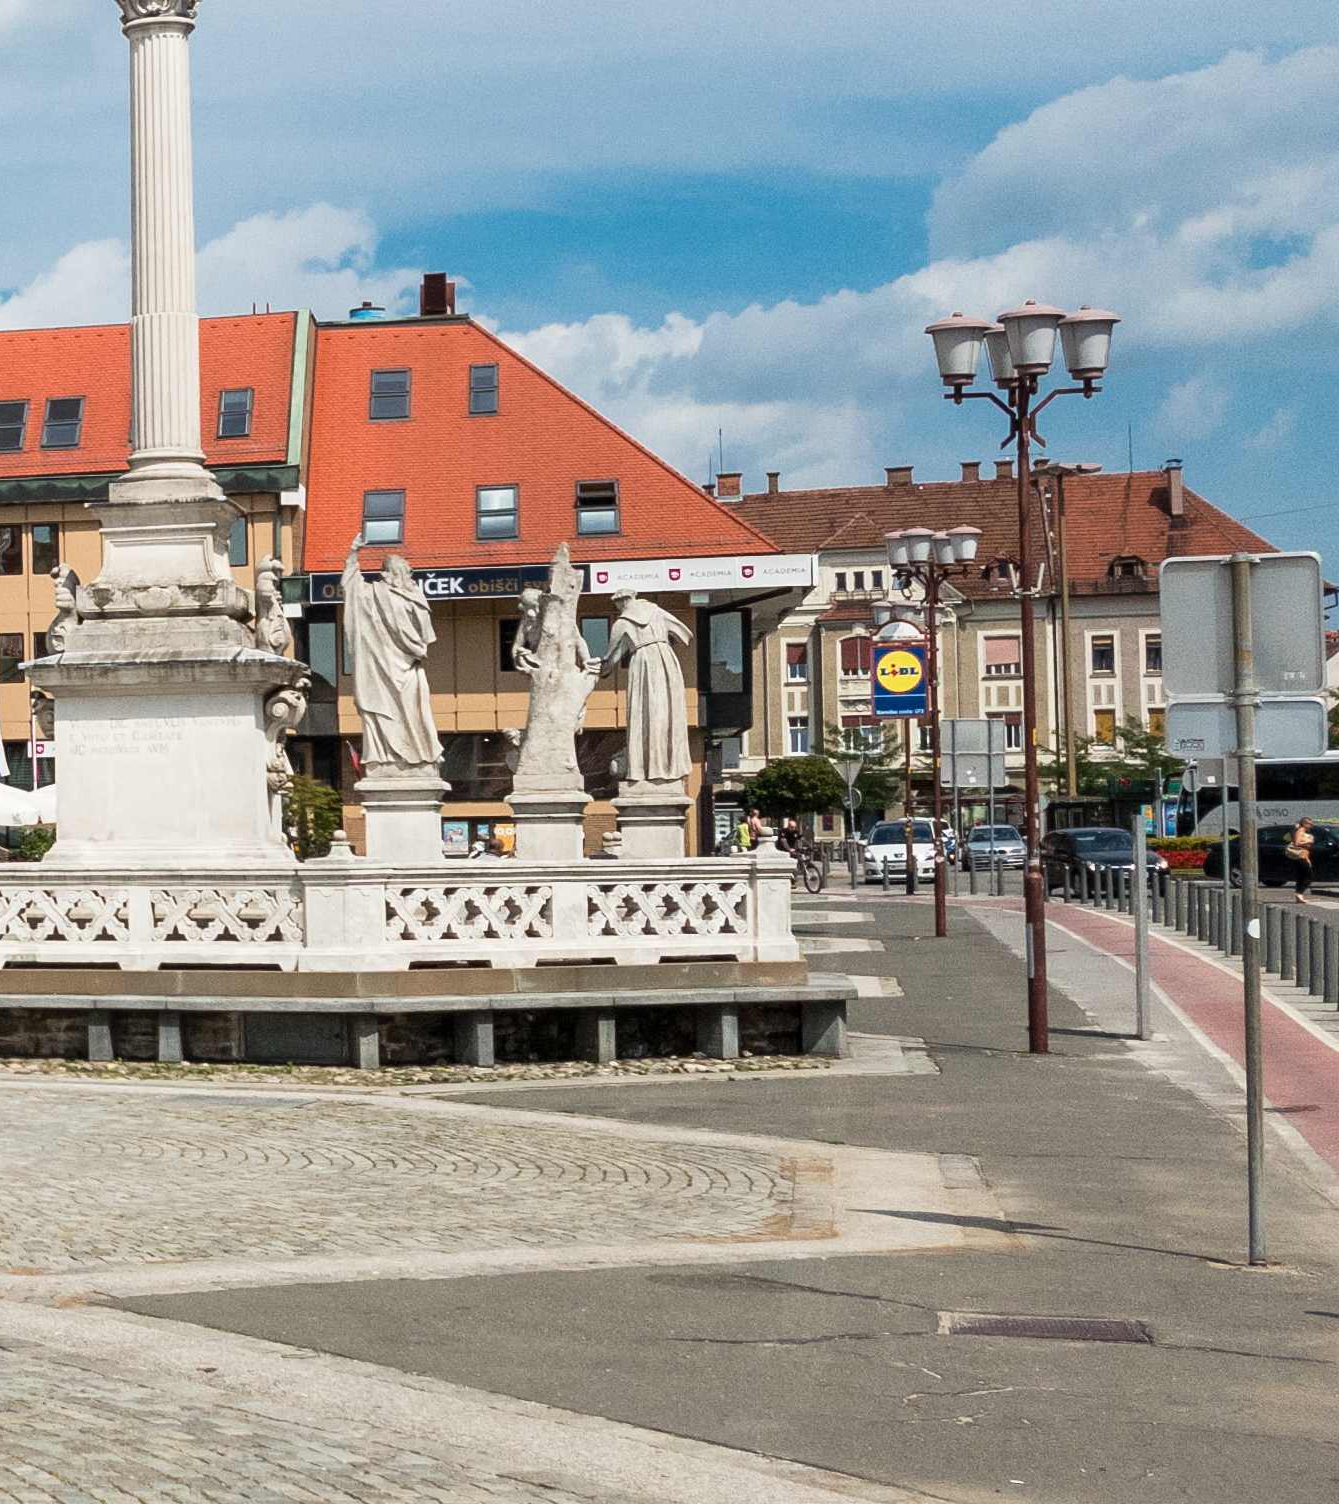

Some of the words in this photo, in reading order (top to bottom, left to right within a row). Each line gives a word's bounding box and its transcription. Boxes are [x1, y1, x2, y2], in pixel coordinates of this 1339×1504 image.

[689, 570, 732, 578] ACADEMIA
[762, 567, 806, 575] ACADEMIA
[617, 573, 659, 581] ACADEMIA
[468, 578, 519, 593] obišči
[880, 663, 920, 677] LIDL
